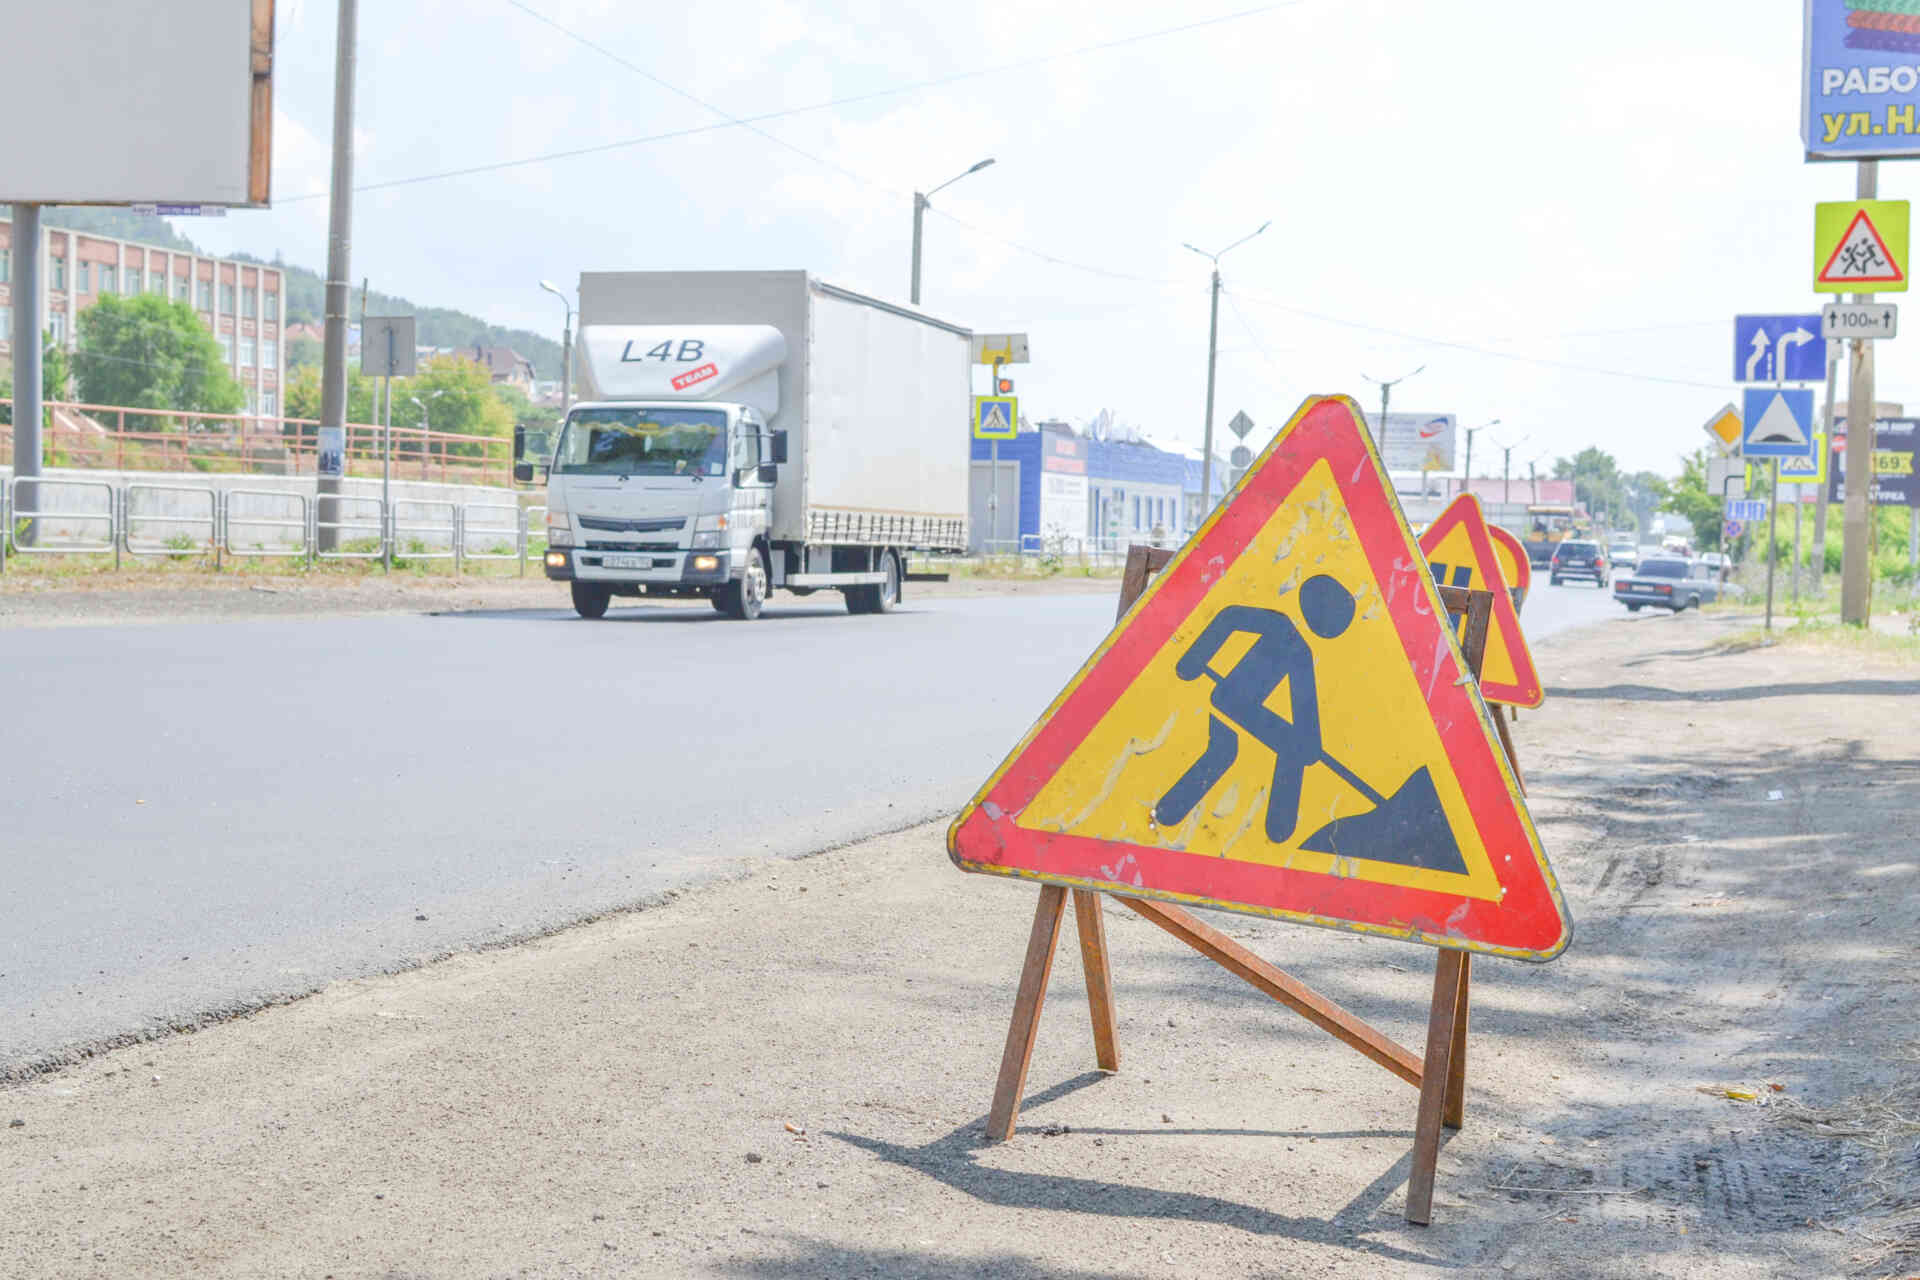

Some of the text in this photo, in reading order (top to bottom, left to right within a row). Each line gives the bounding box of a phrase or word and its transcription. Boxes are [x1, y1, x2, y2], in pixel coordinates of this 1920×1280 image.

[1823, 65, 1920, 95] РАБО
[1822, 104, 1920, 143] ул.Н
[620, 339, 705, 362] L4B
[675, 365, 714, 387] TEAM
